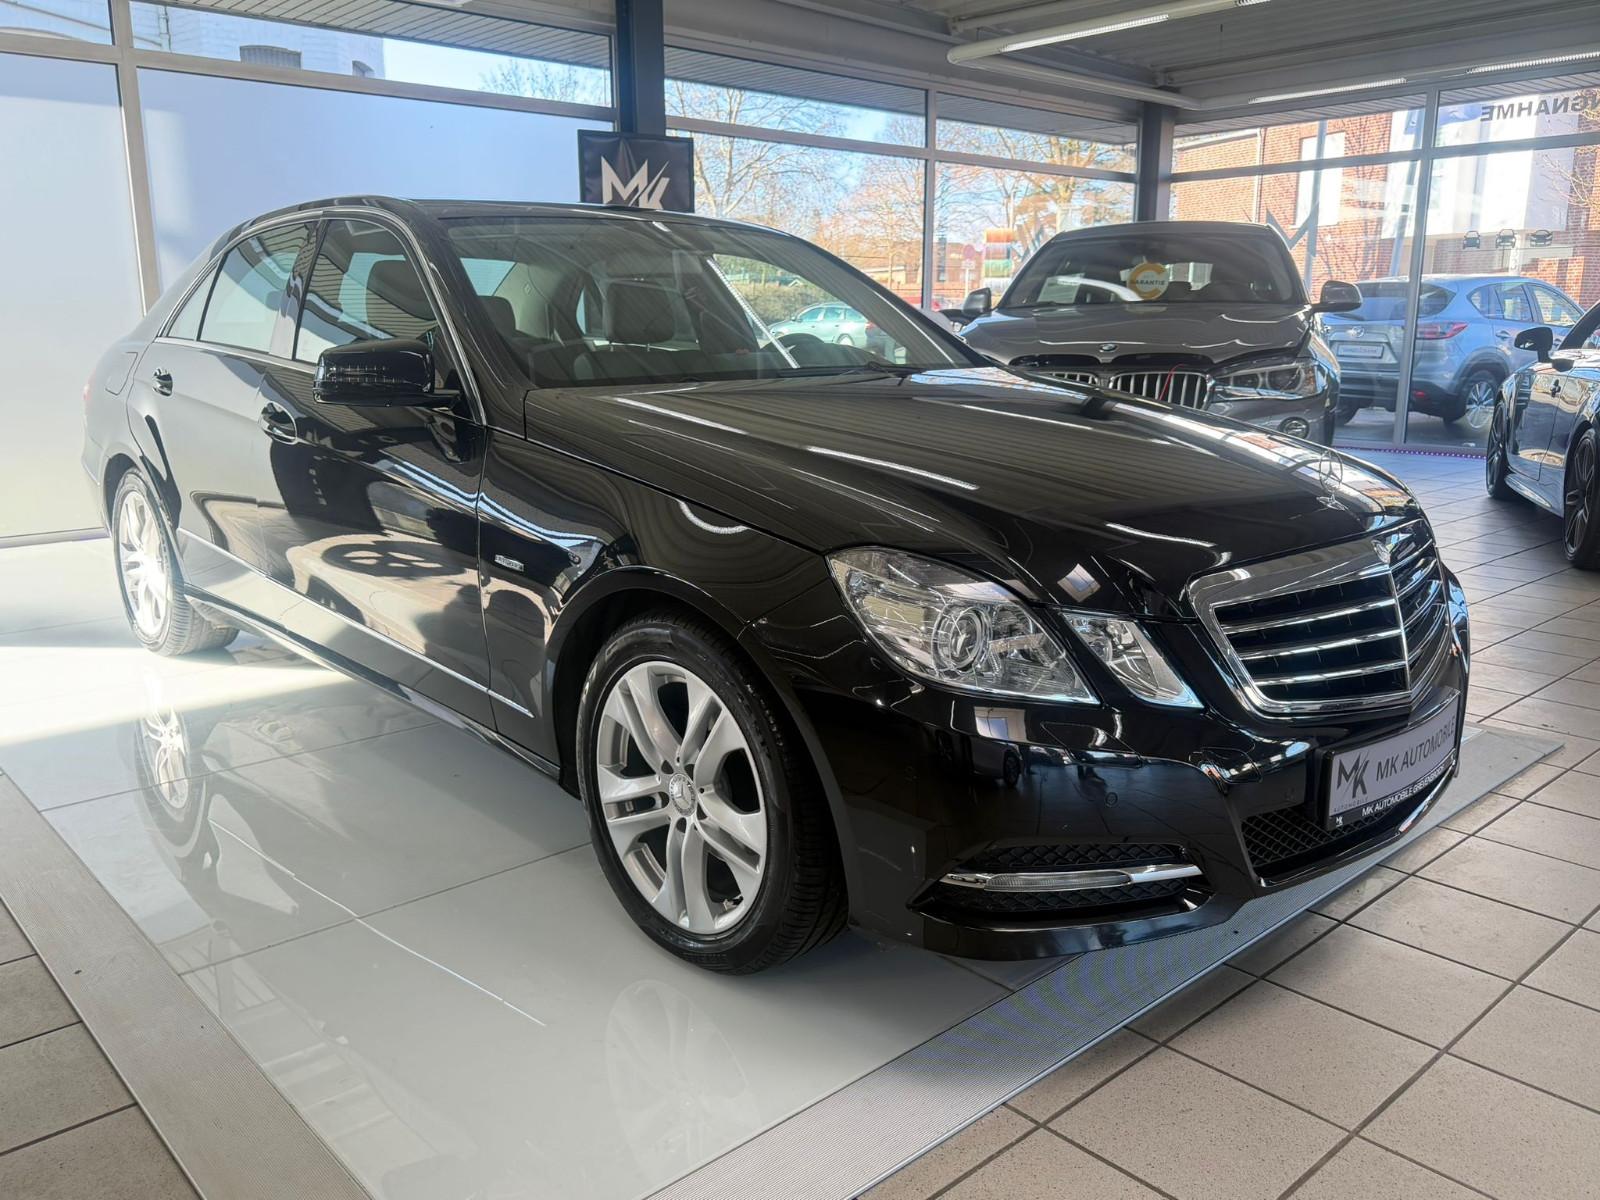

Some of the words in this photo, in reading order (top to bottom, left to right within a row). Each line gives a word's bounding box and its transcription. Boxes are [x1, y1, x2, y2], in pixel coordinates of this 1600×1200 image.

[1376, 754, 1400, 782] MK
[1400, 716, 1456, 772] AUTOMOBILE
[1337, 752, 1370, 799] MK
[1362, 804, 1375, 817] MK
[1374, 788, 1413, 813] AUTOMOBILE
